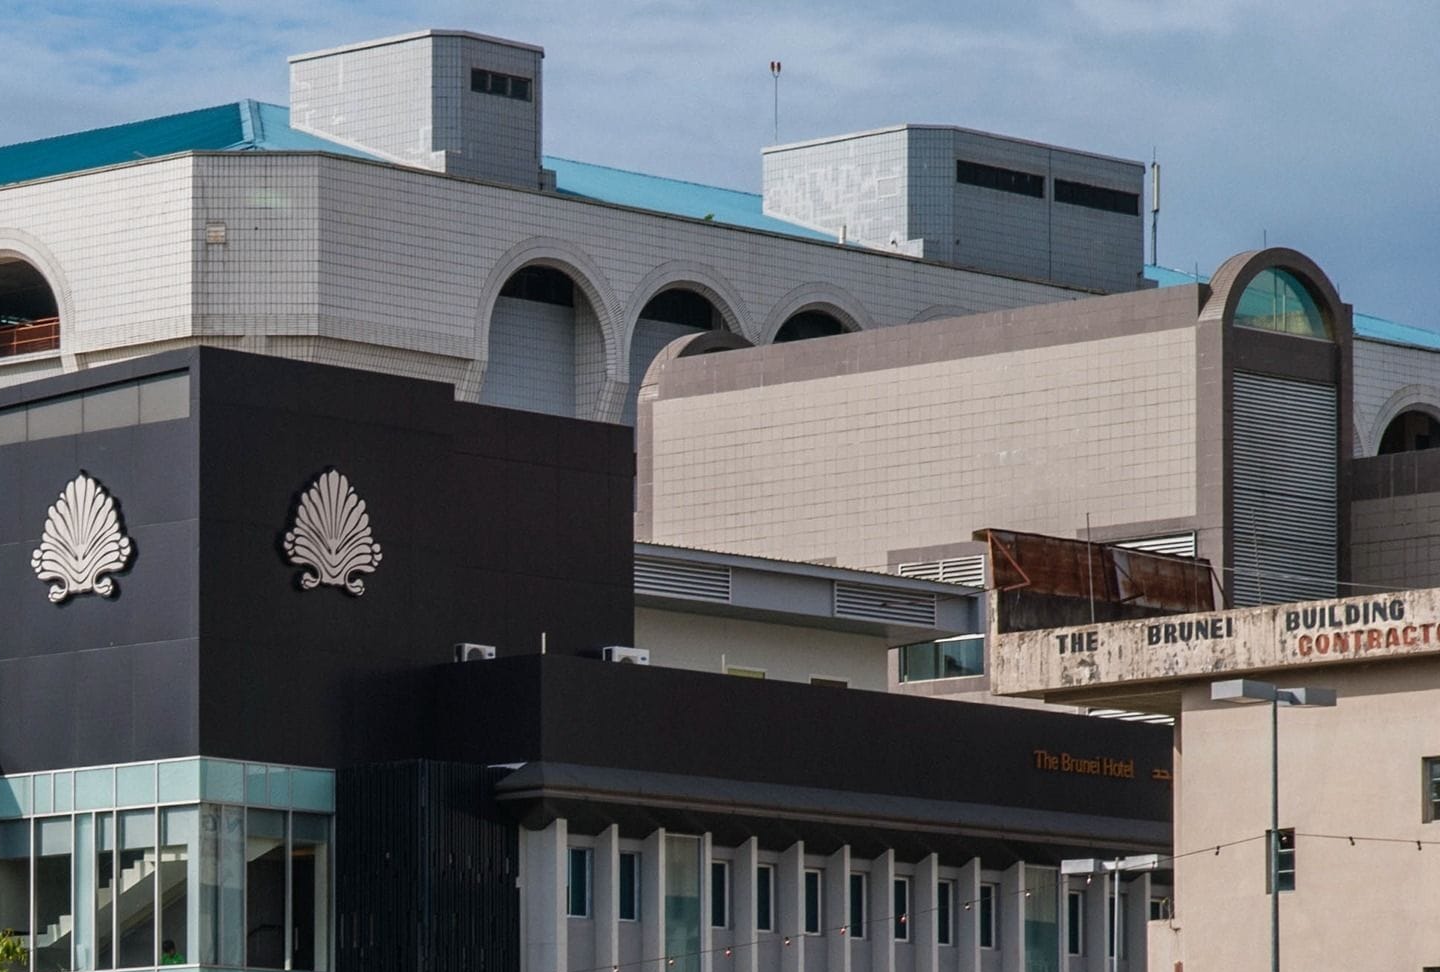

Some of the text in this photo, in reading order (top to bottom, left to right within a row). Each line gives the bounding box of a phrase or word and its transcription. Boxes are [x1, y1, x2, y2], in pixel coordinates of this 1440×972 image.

[1056, 600, 1405, 655] THE BRUNEI BUILDING
[1298, 622, 1440, 657] CONTRACT
[1033, 750, 1059, 769] The
[1061, 753, 1100, 774] Brunei
[1103, 757, 1135, 779] Hotel
